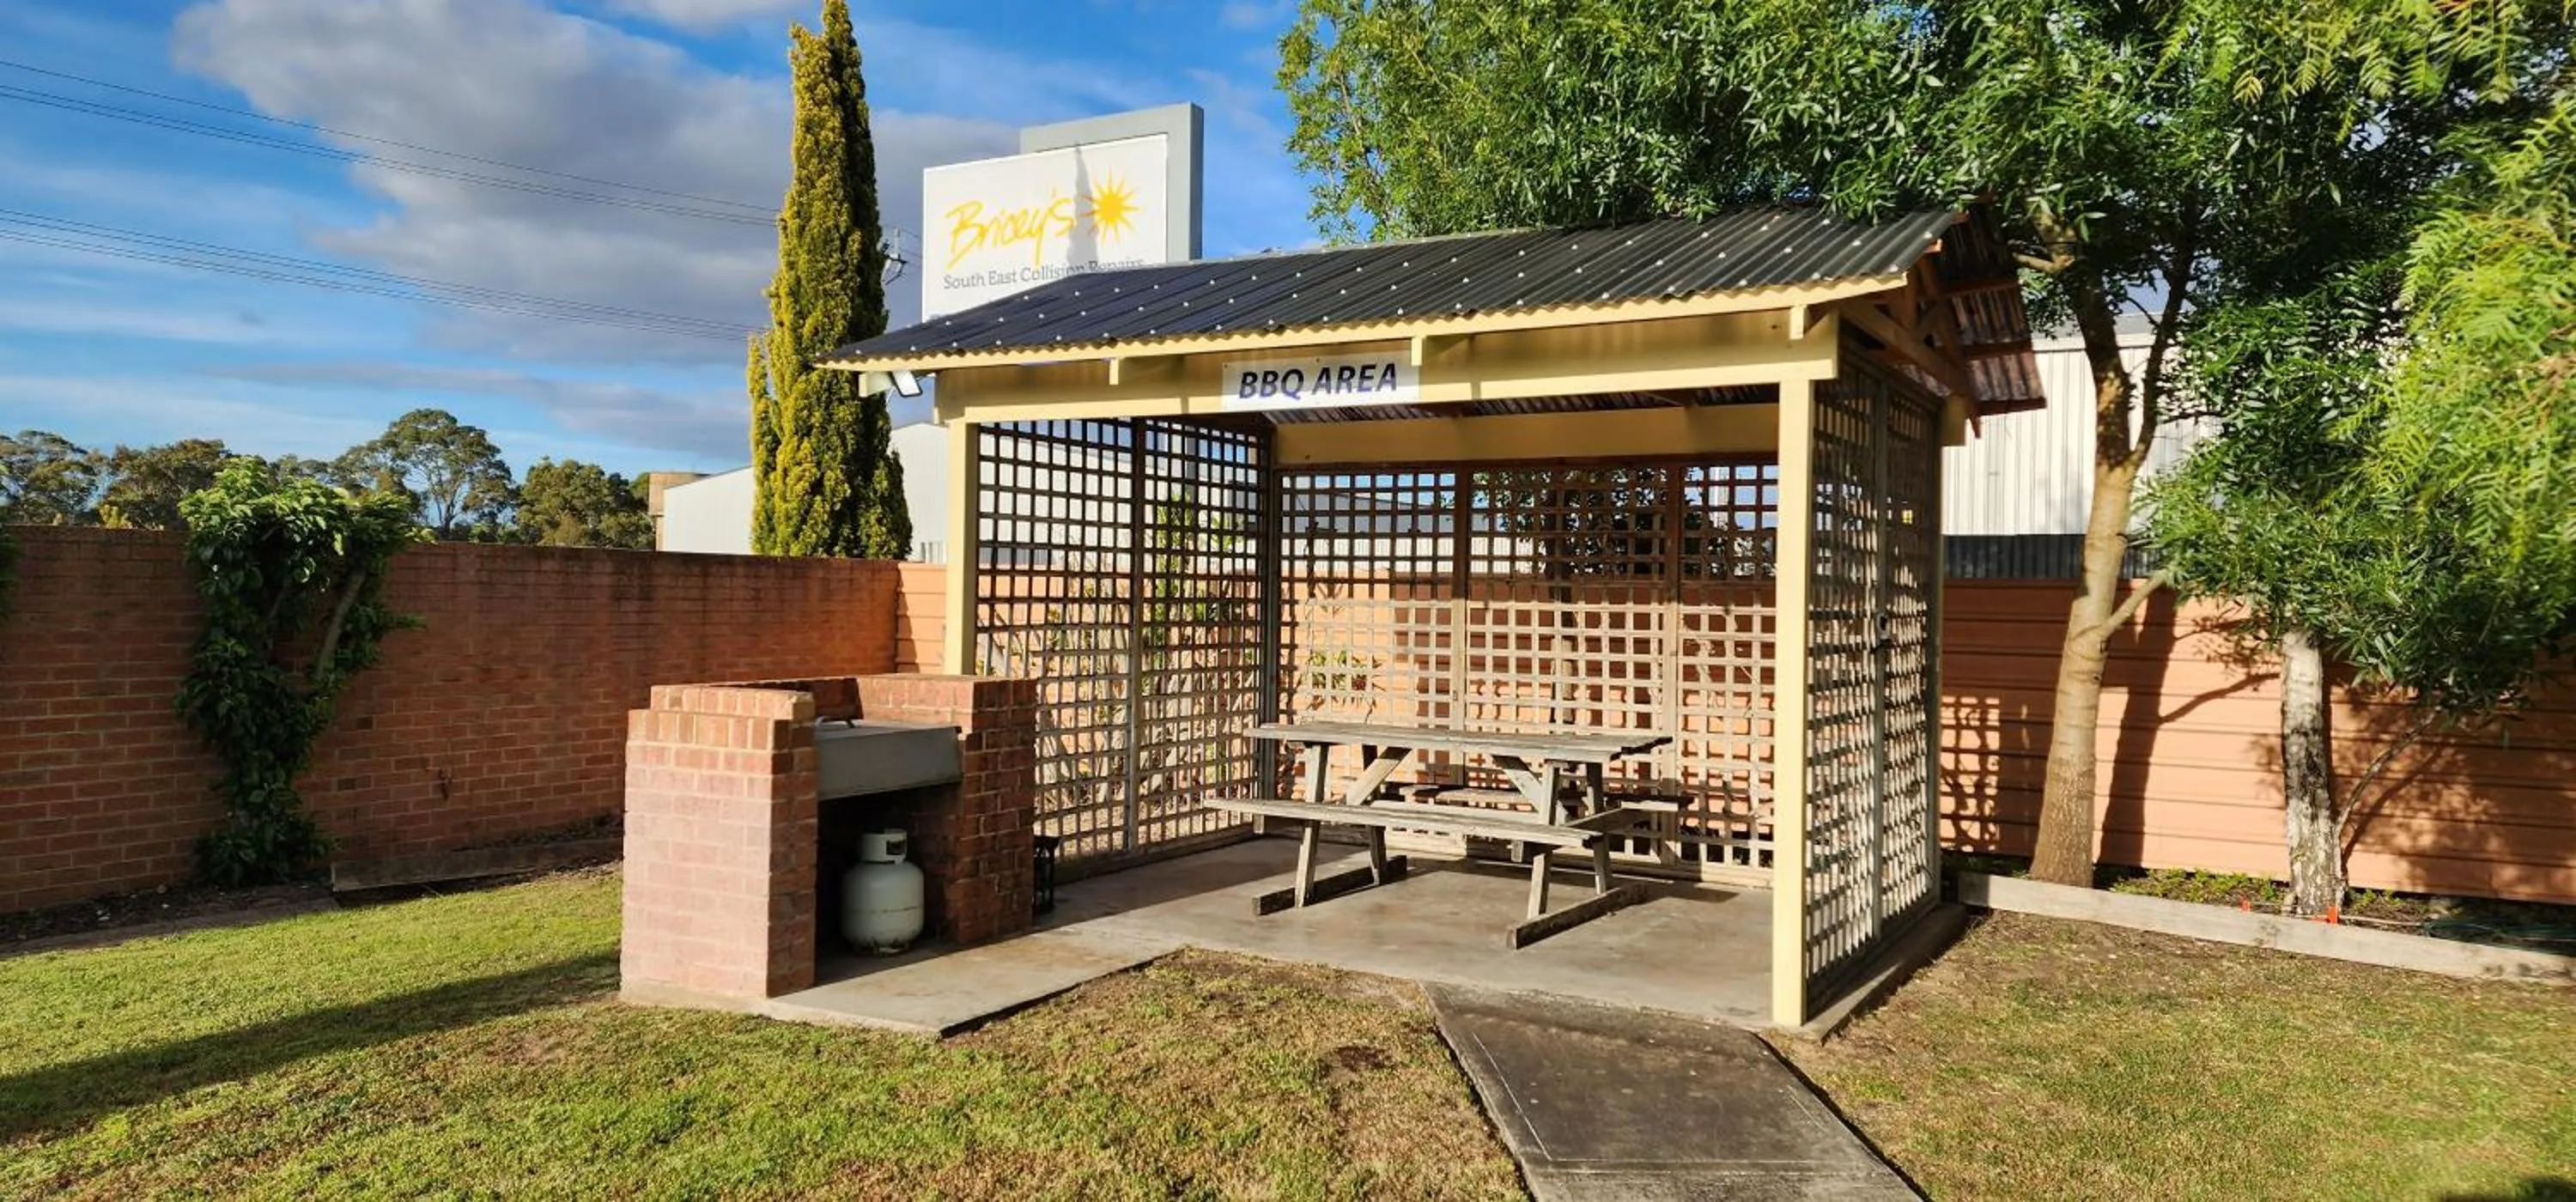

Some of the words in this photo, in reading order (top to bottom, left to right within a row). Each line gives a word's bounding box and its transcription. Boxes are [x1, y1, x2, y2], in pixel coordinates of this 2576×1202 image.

[944, 273, 985, 289] South
[988, 270, 1018, 285] East
[1020, 264, 1084, 282] Collision
[1239, 369, 1304, 400] BBQ
[1311, 362, 1396, 395] AREA
